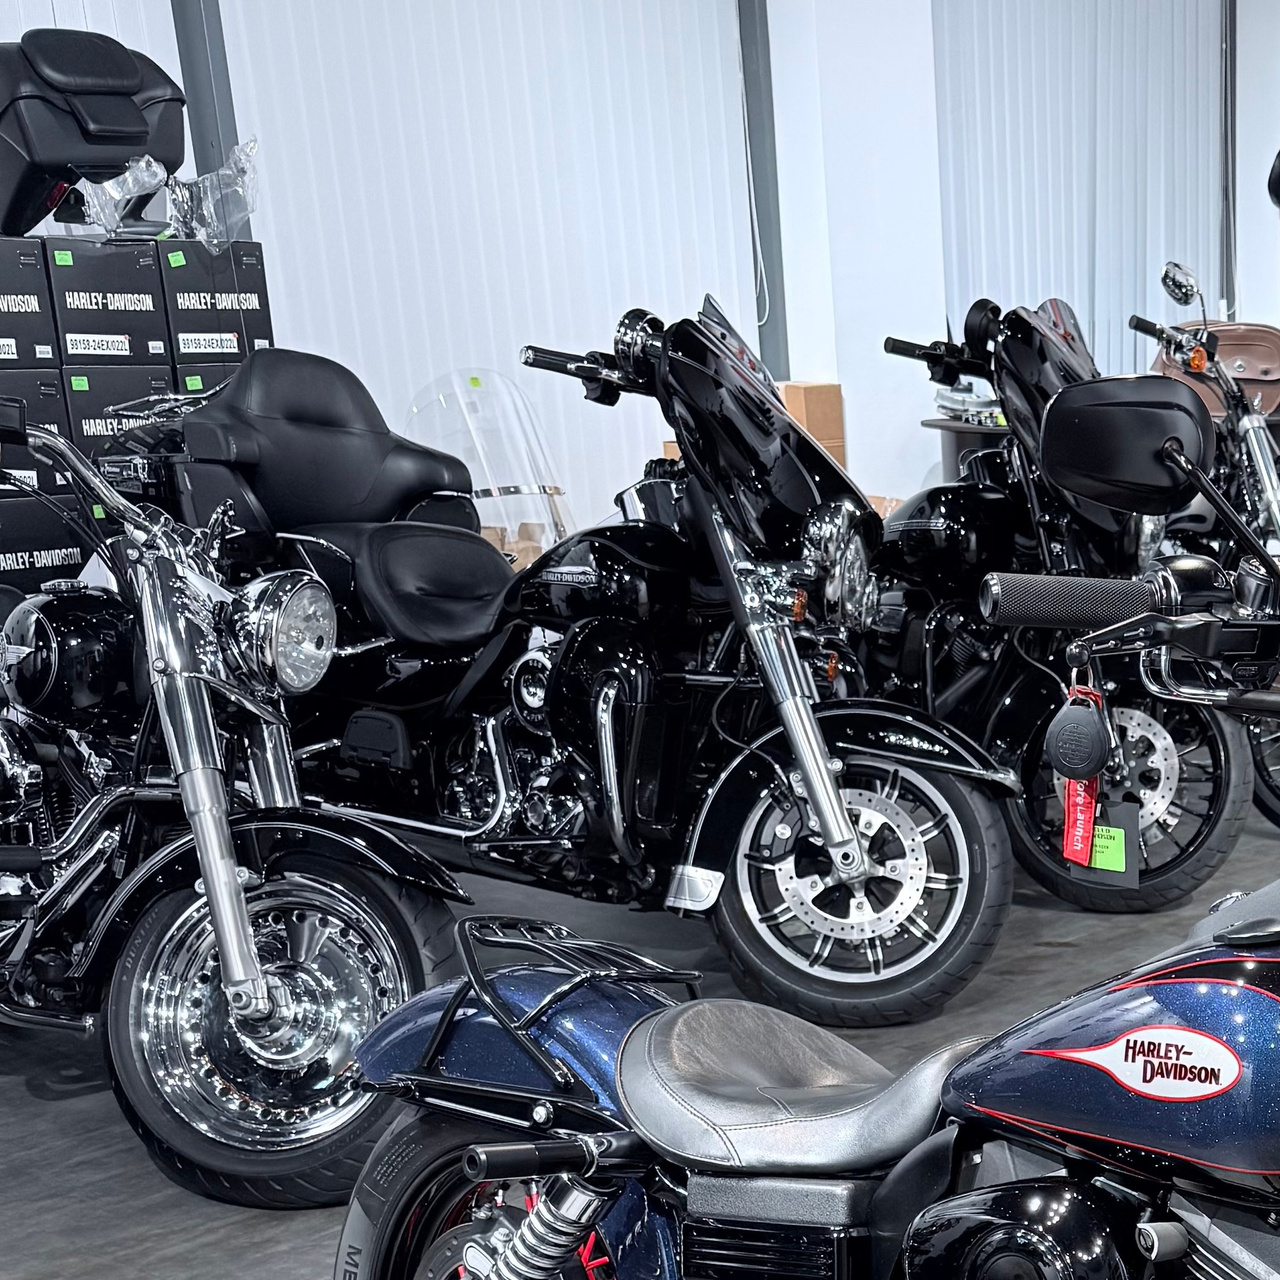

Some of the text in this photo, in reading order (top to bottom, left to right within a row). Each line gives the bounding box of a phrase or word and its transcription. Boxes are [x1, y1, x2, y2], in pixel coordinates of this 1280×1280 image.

[65, 291, 154, 311] HARLEY-DAVIDSON
[176, 292, 260, 310] HARLEY-DAVIDSON
[1073, 806, 1087, 850] Launch
[1142, 1060, 1221, 1085] DAVIDSON
